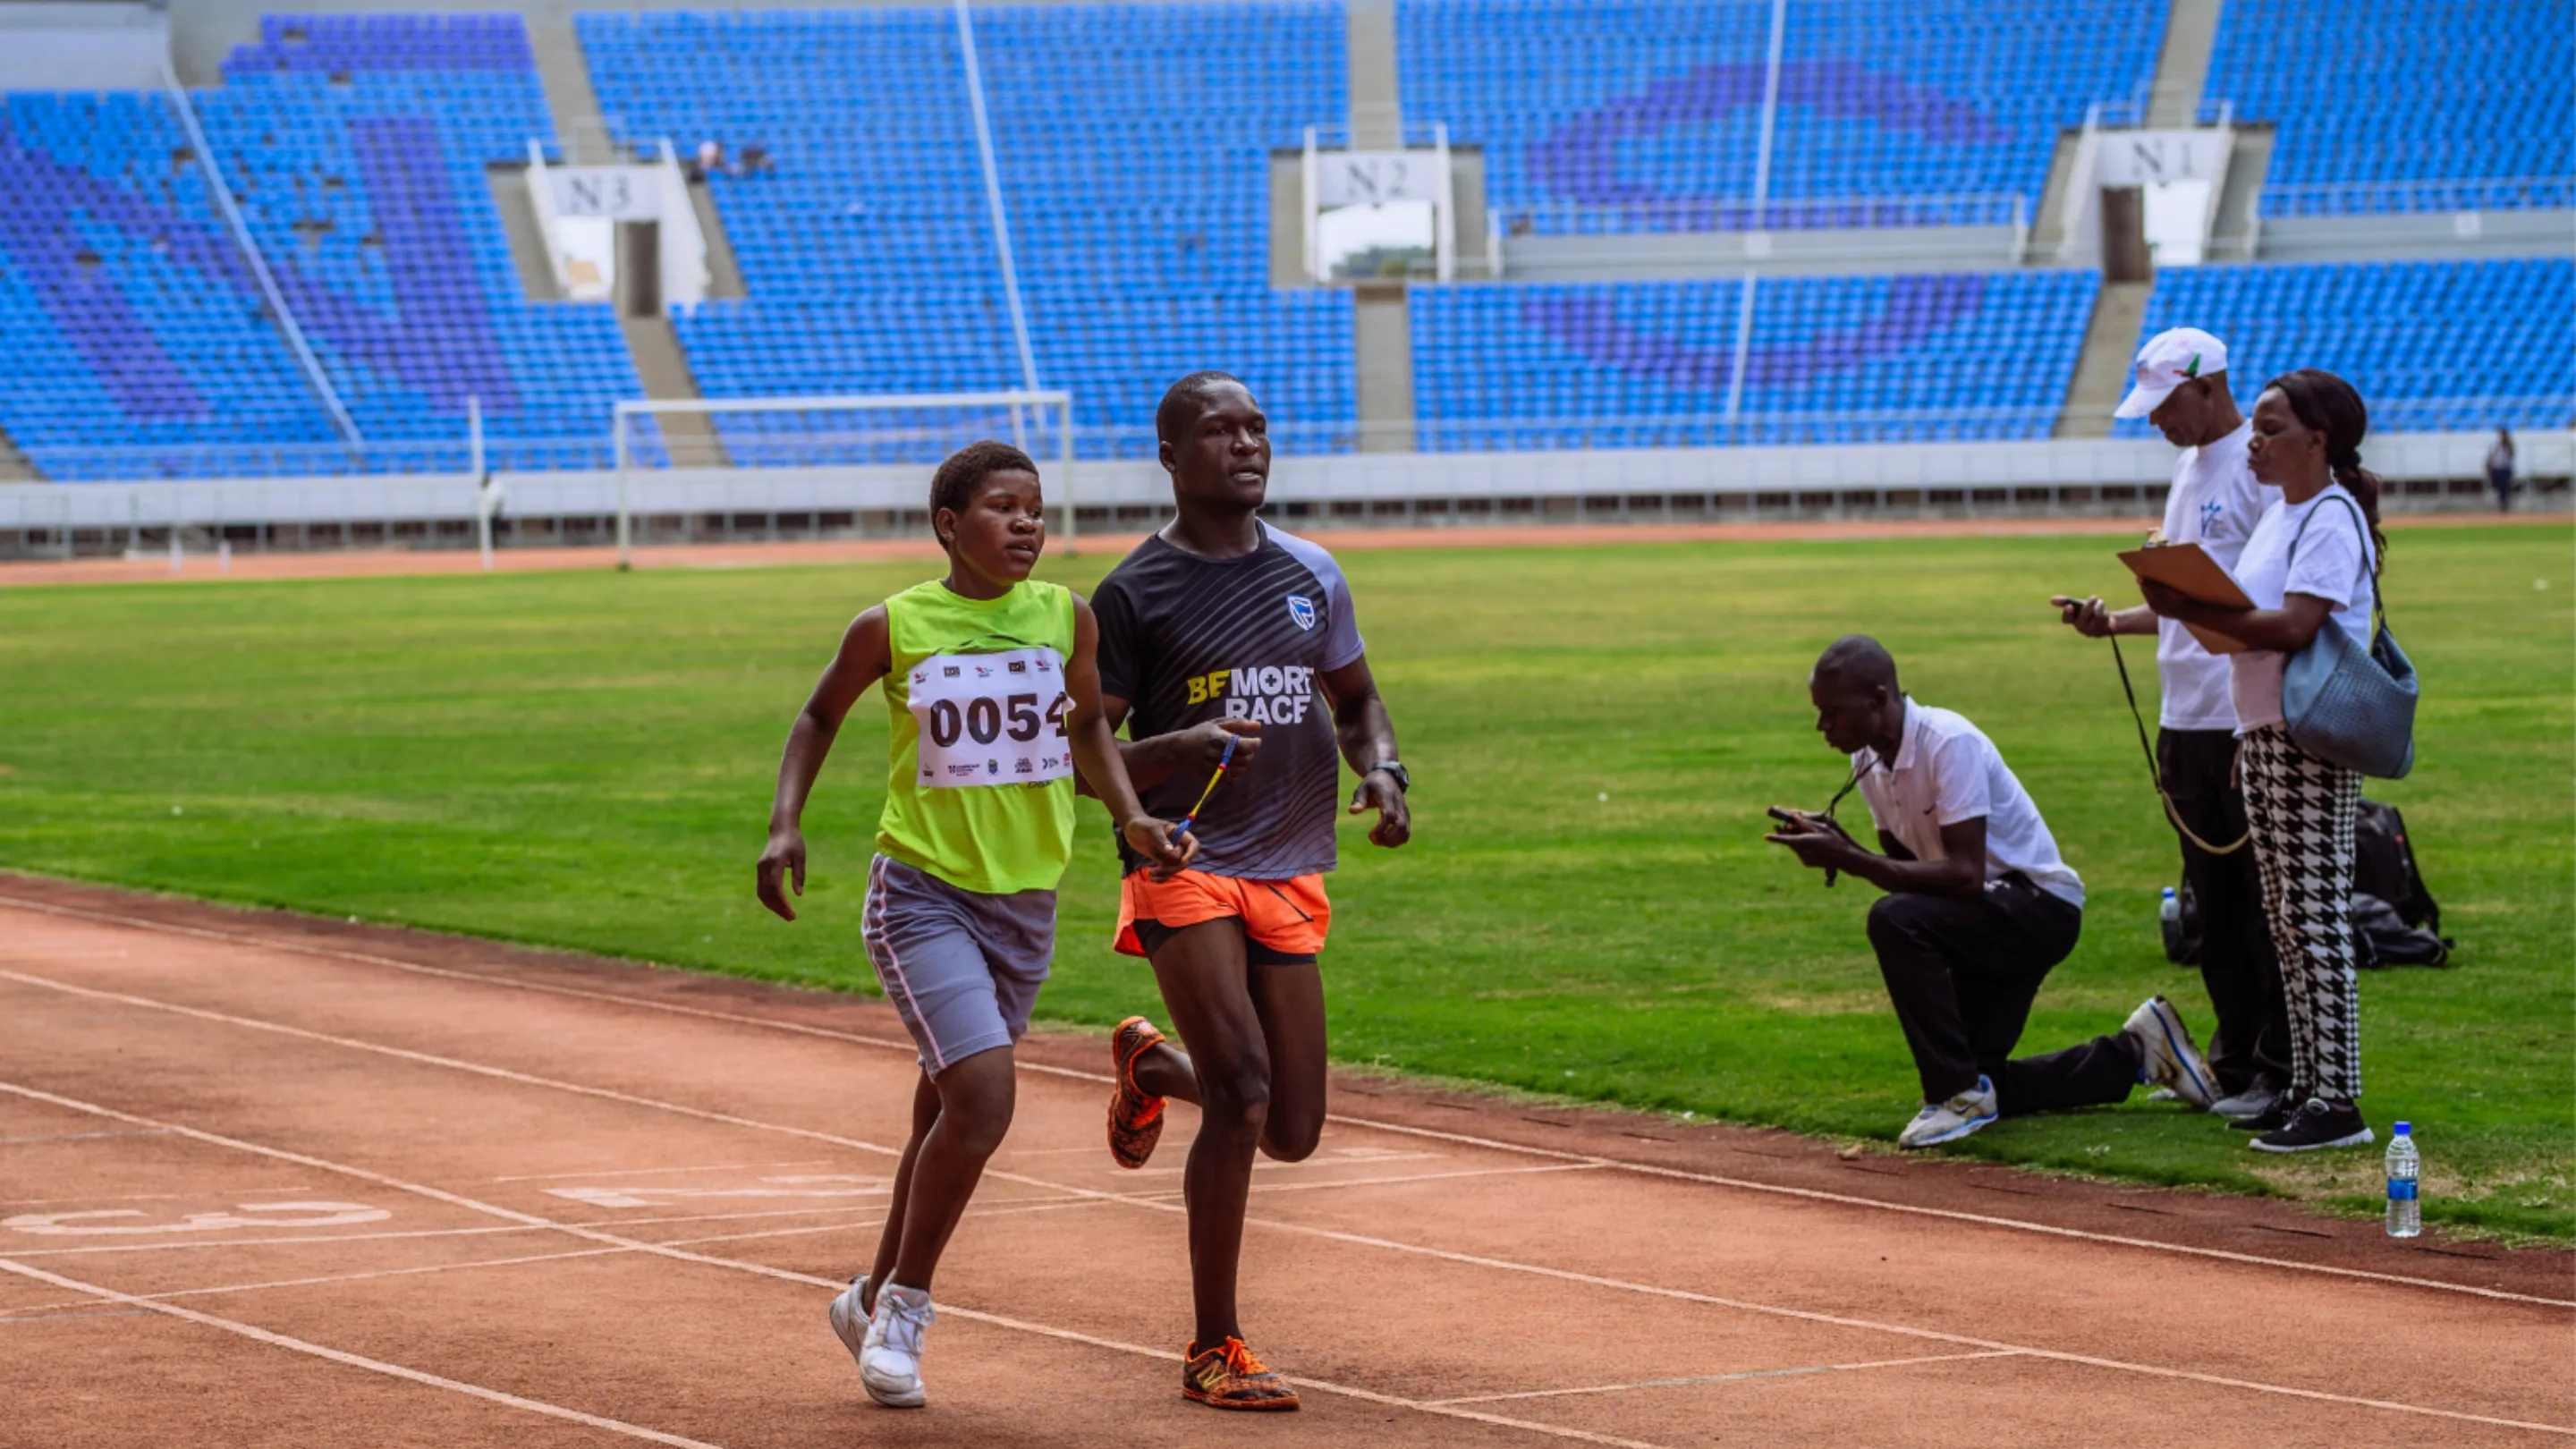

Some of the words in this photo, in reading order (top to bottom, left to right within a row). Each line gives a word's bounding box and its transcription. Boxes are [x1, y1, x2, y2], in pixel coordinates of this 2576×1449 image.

[2131, 139, 2193, 177] N1
[569, 174, 631, 214] N3
[1345, 159, 1408, 199] N2
[930, 691, 1069, 748] 0054
